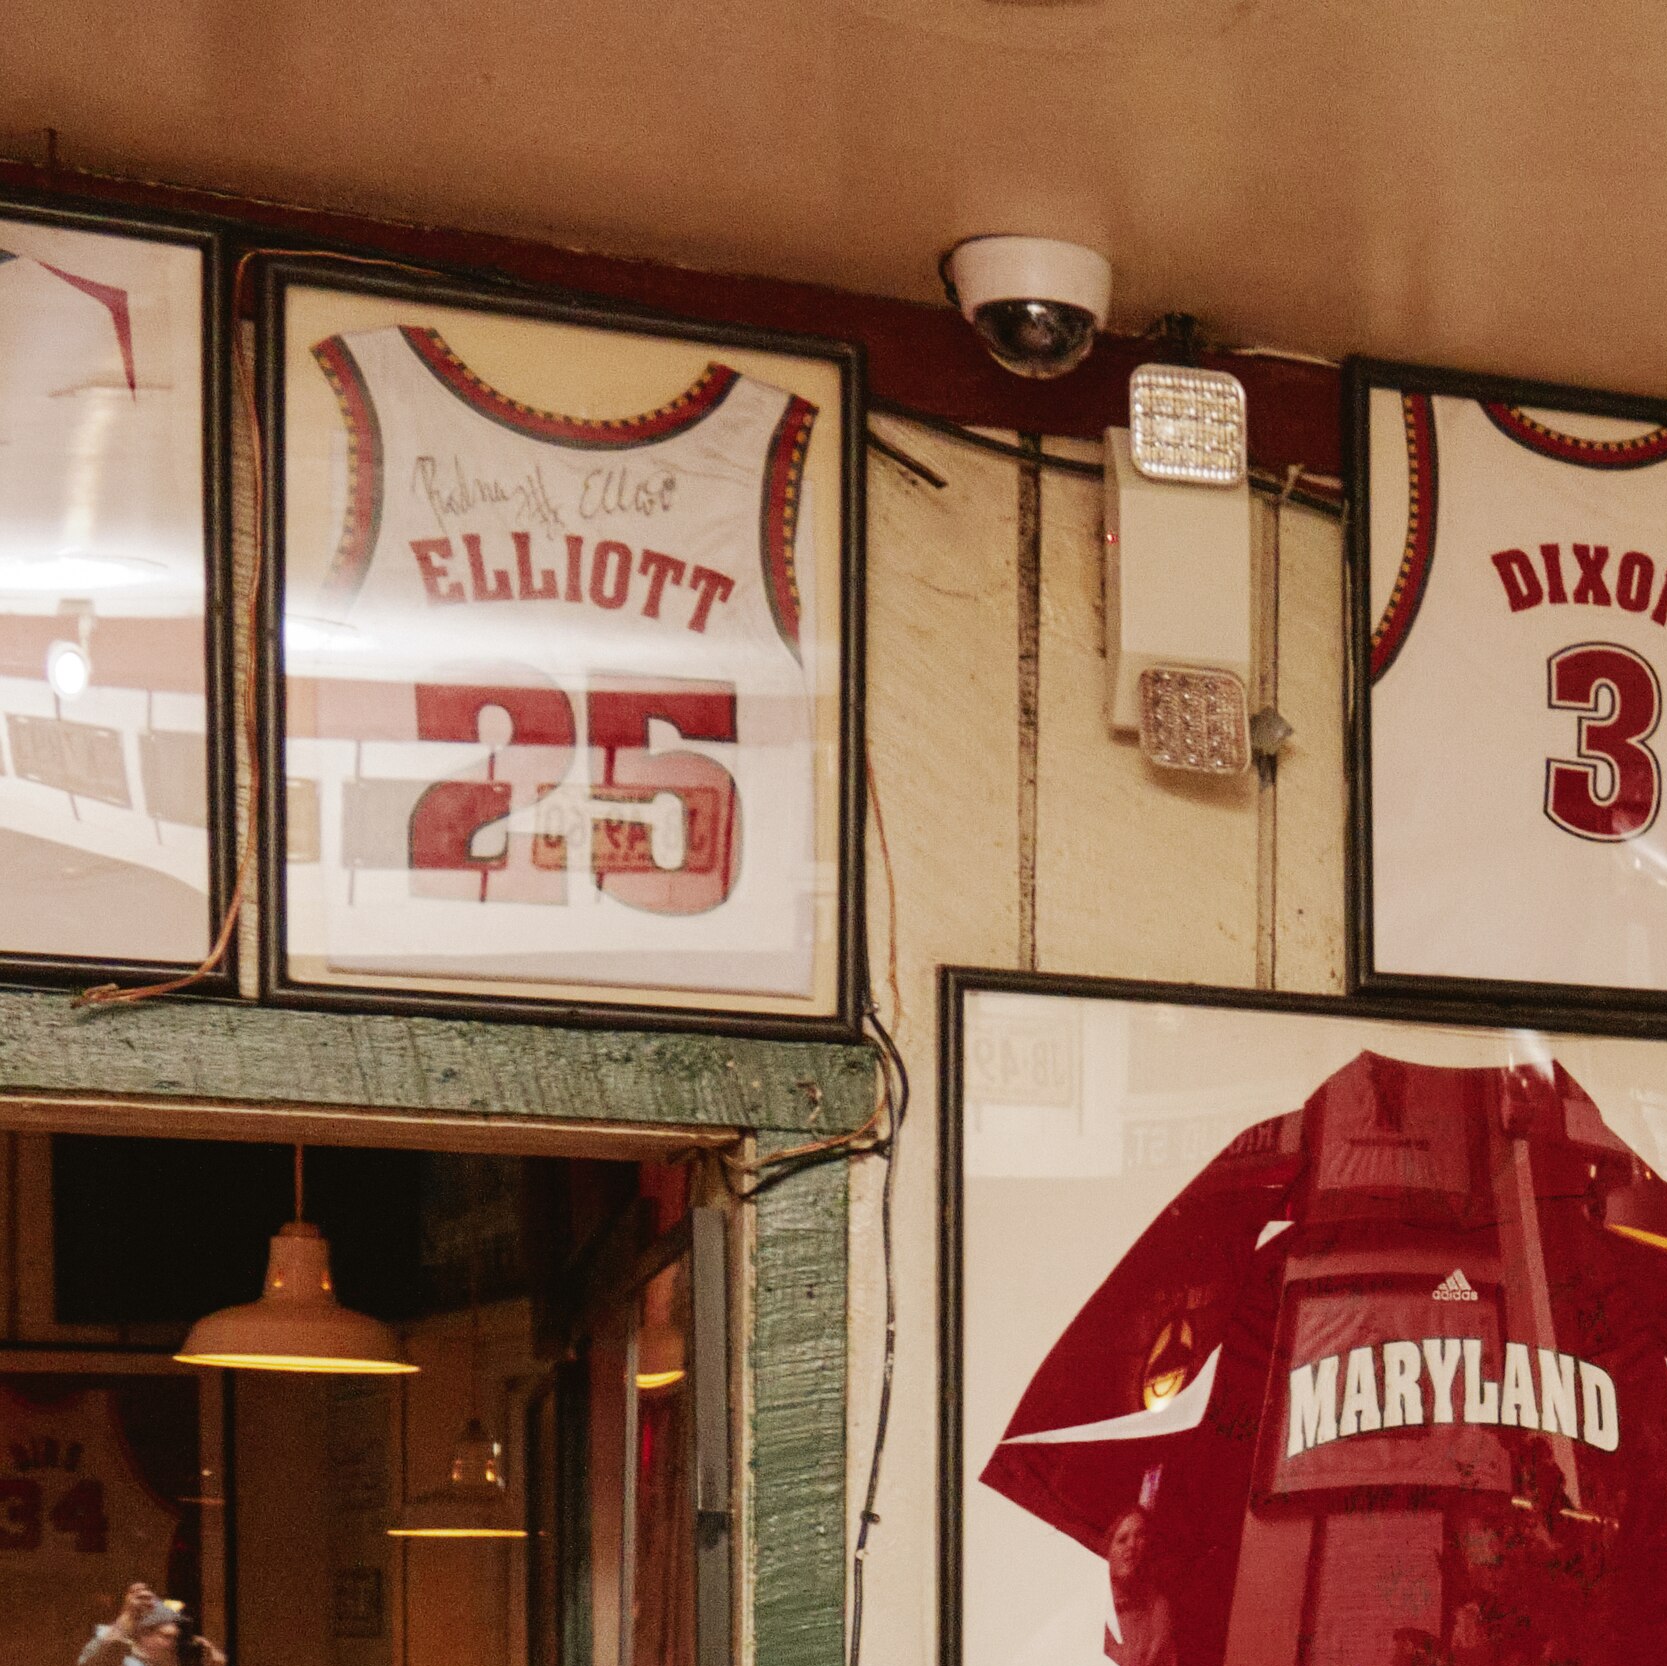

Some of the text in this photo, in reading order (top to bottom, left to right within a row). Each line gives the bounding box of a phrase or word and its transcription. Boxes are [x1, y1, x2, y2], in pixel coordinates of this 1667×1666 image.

[408, 531, 736, 634] ELLIOTT
[408, 659, 744, 918] 25
[1543, 640, 1663, 843] 3
[1432, 1288, 1478, 1301] adidas
[1286, 1336, 1620, 1459] MARYLAND
